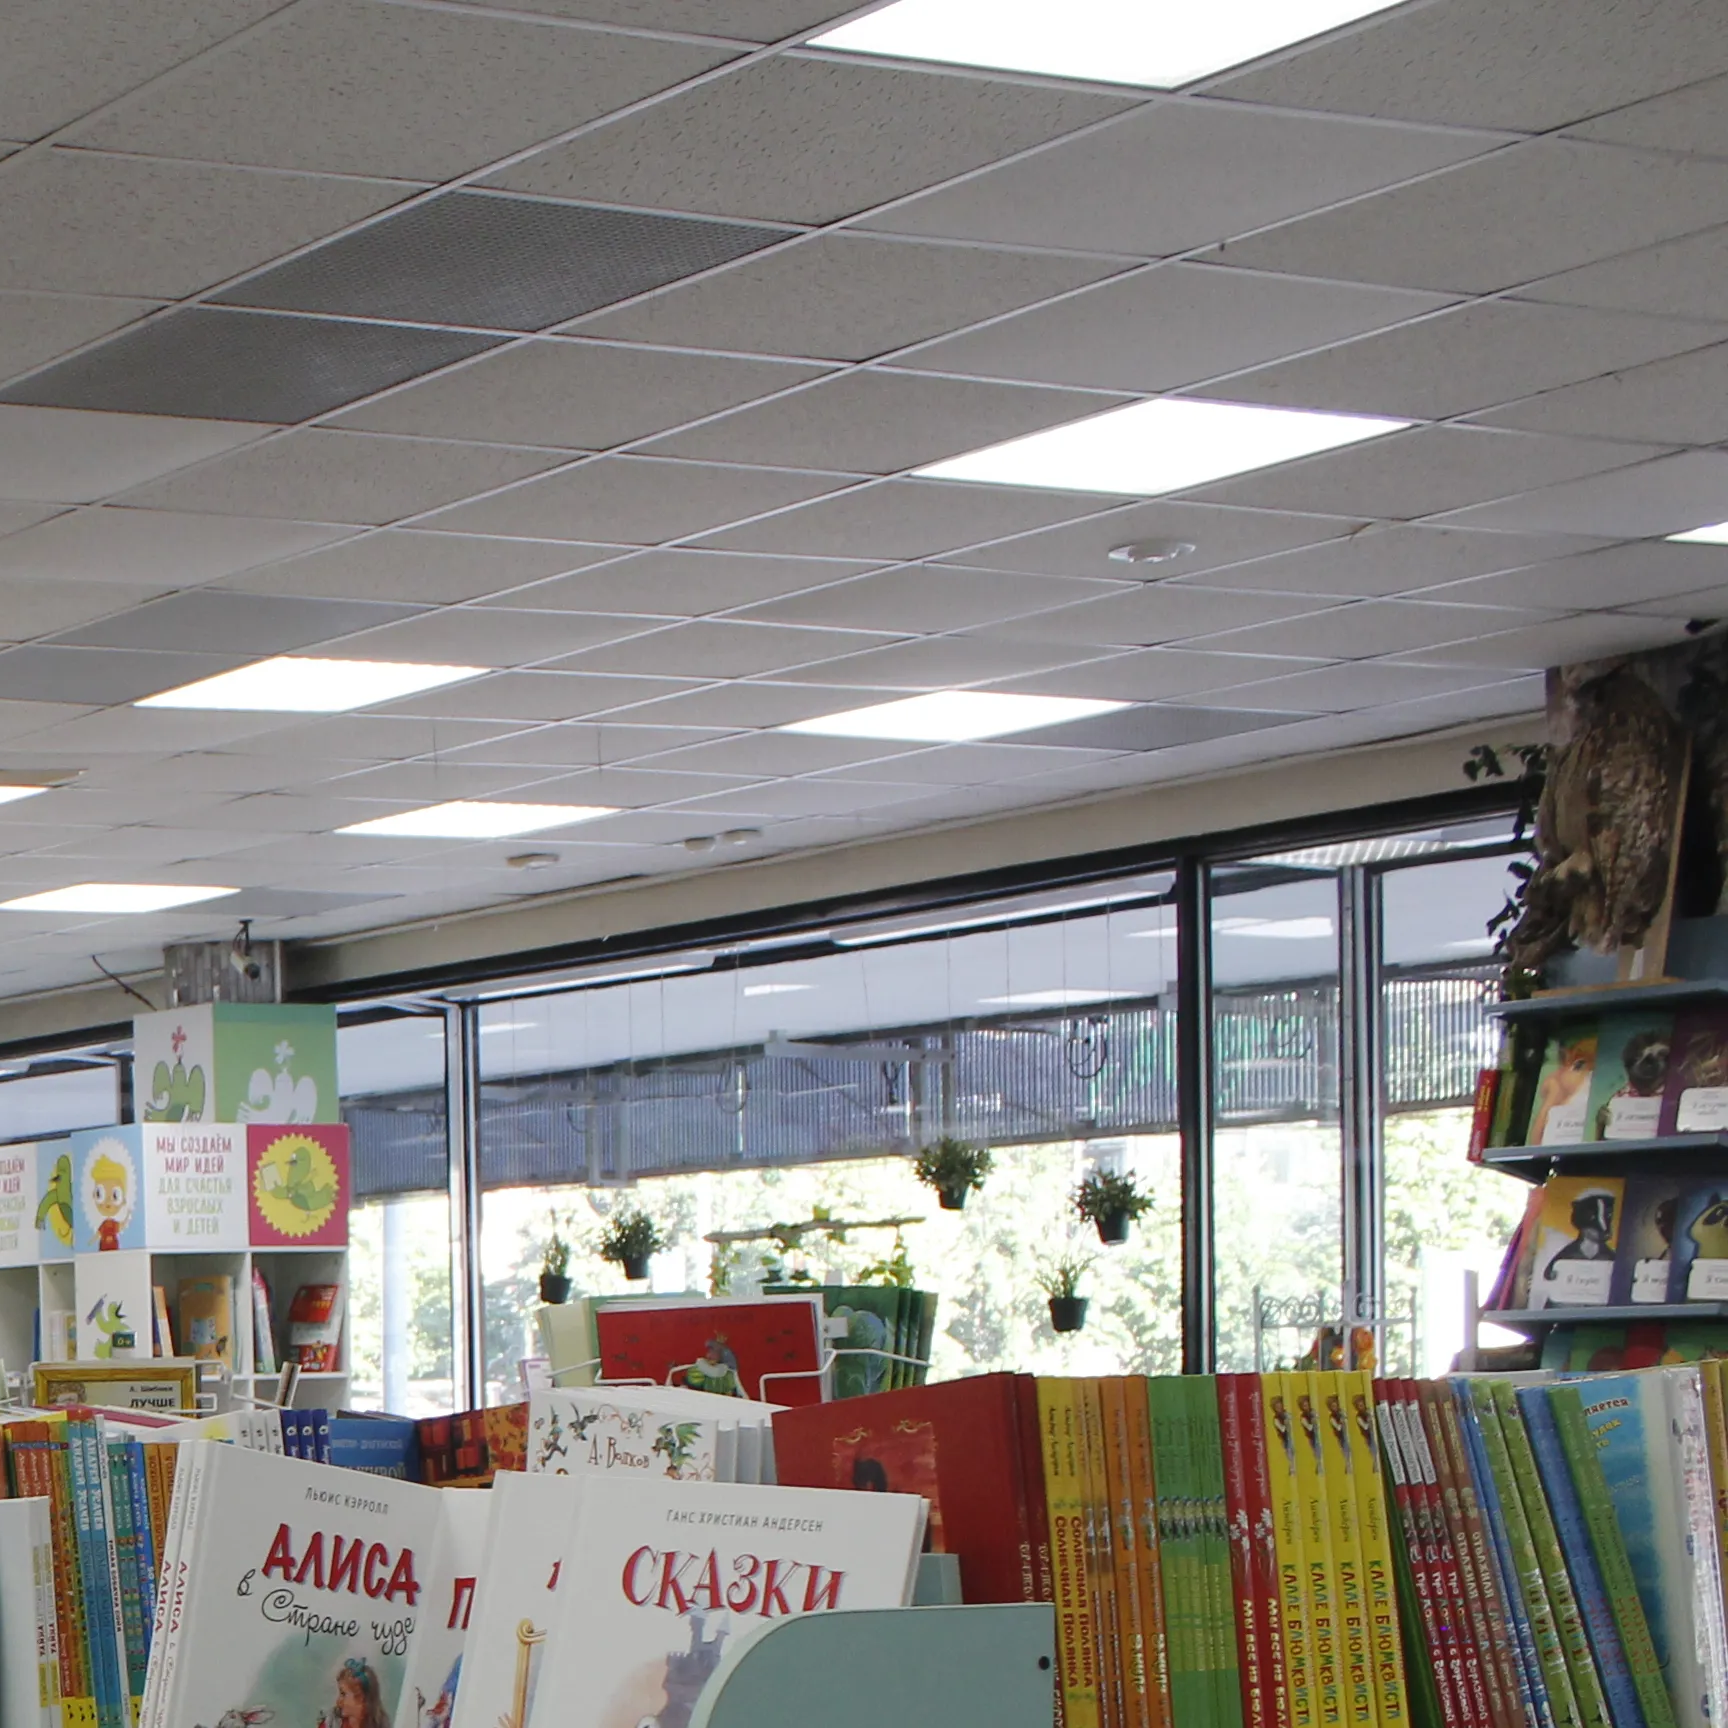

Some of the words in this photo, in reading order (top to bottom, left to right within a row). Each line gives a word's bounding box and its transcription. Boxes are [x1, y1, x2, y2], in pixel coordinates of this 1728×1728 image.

[155, 1137, 178, 1154] МЫ
[164, 1156, 192, 1174] МИР
[195, 1153, 225, 1174] ИДЕЙ
[158, 1177, 183, 1195] ДЛЯ
[304, 1486, 341, 1514] ЛЬЮИС
[342, 1491, 389, 1516] КЭРРОЛЛ
[665, 1507, 698, 1529] ГАНС
[699, 1509, 759, 1532] ХРИСТИАН
[760, 1513, 824, 1534] АНДЕРСЕН
[154, 1561, 172, 1632] АЛИСА
[170, 1561, 189, 1633] АЛИСА
[259, 1520, 420, 1608] АЛИСА
[619, 1543, 849, 1620] СКАЗКИ
[1055, 1515, 1071, 1608] СОЛНЕЧНАЯ
[1071, 1516, 1088, 1608] СОЛНЕЧНАЯ
[1282, 1564, 1300, 1613] КАЛЛЕ
[1310, 1562, 1330, 1612] КАЛЛЕ
[1340, 1561, 1359, 1610] КАЛЛЕ
[1369, 1560, 1390, 1608] КАЛЛЕ
[259, 1586, 359, 1648] Стране
[1062, 1613, 1079, 1688] ПОЛЯНКА
[1077, 1613, 1094, 1688] ПОЛЯНКА
[1287, 1620, 1312, 1726] БЛЮМКВИСТА
[1315, 1618, 1340, 1723] БЛЮМКВИСТА
[1346, 1617, 1370, 1722] БЛЮМКВИСТА
[1374, 1615, 1401, 1720] БЛЮМКВИСТА
